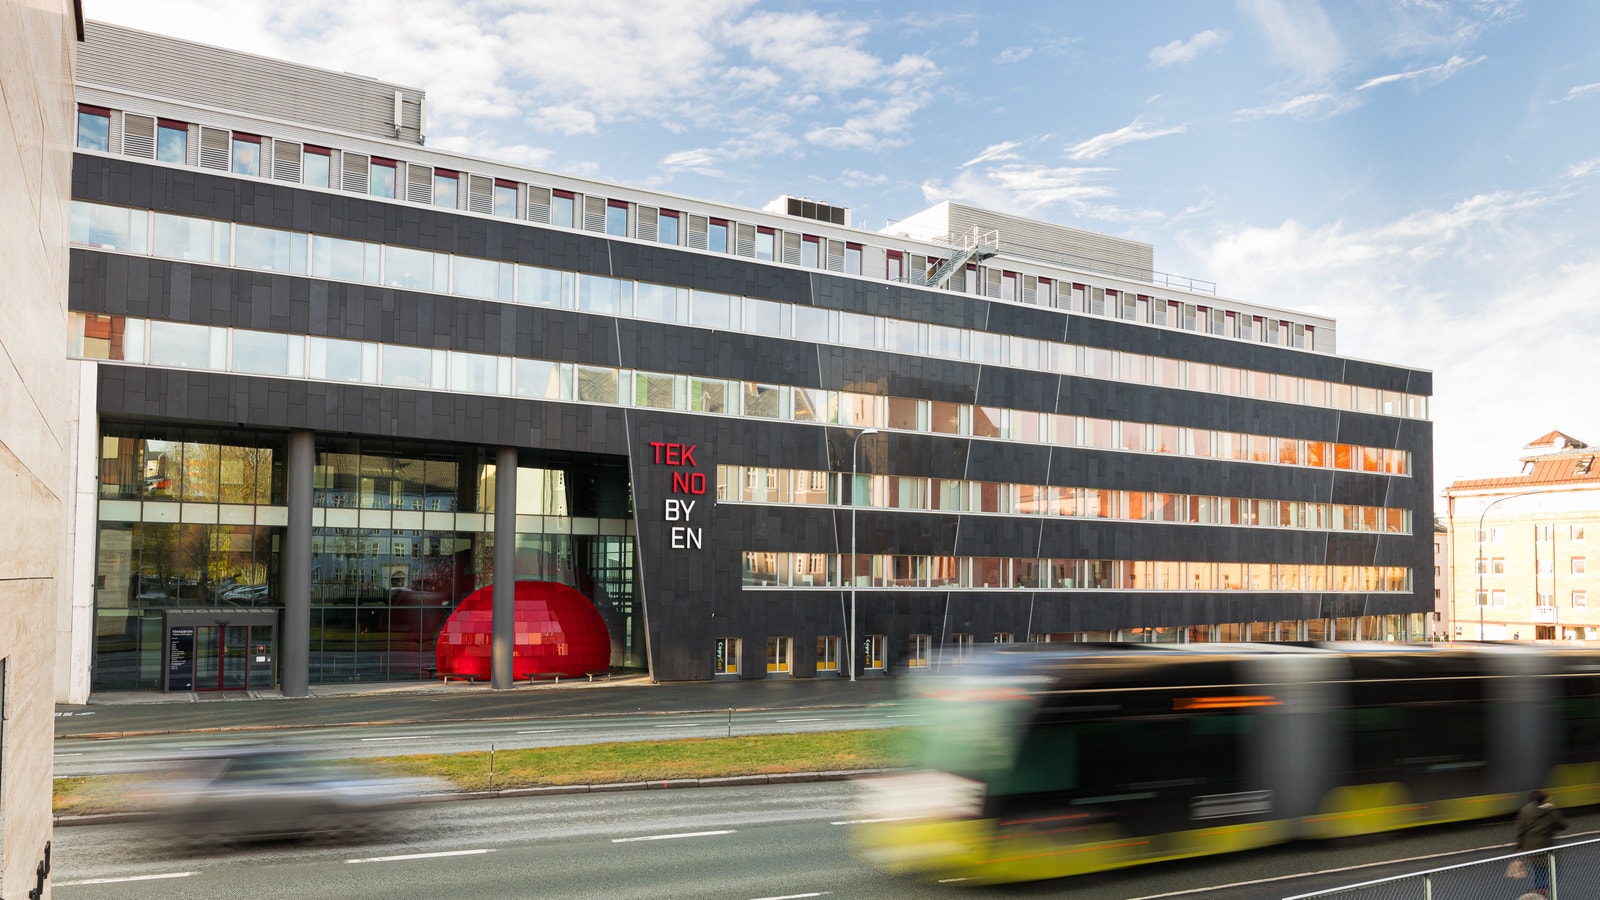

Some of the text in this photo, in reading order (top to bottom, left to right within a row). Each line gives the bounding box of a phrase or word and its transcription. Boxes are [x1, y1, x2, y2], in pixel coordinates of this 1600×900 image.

[649, 441, 697, 467] TEK
[672, 471, 706, 495] NO
[665, 499, 696, 521] BY
[671, 526, 702, 549] EN
